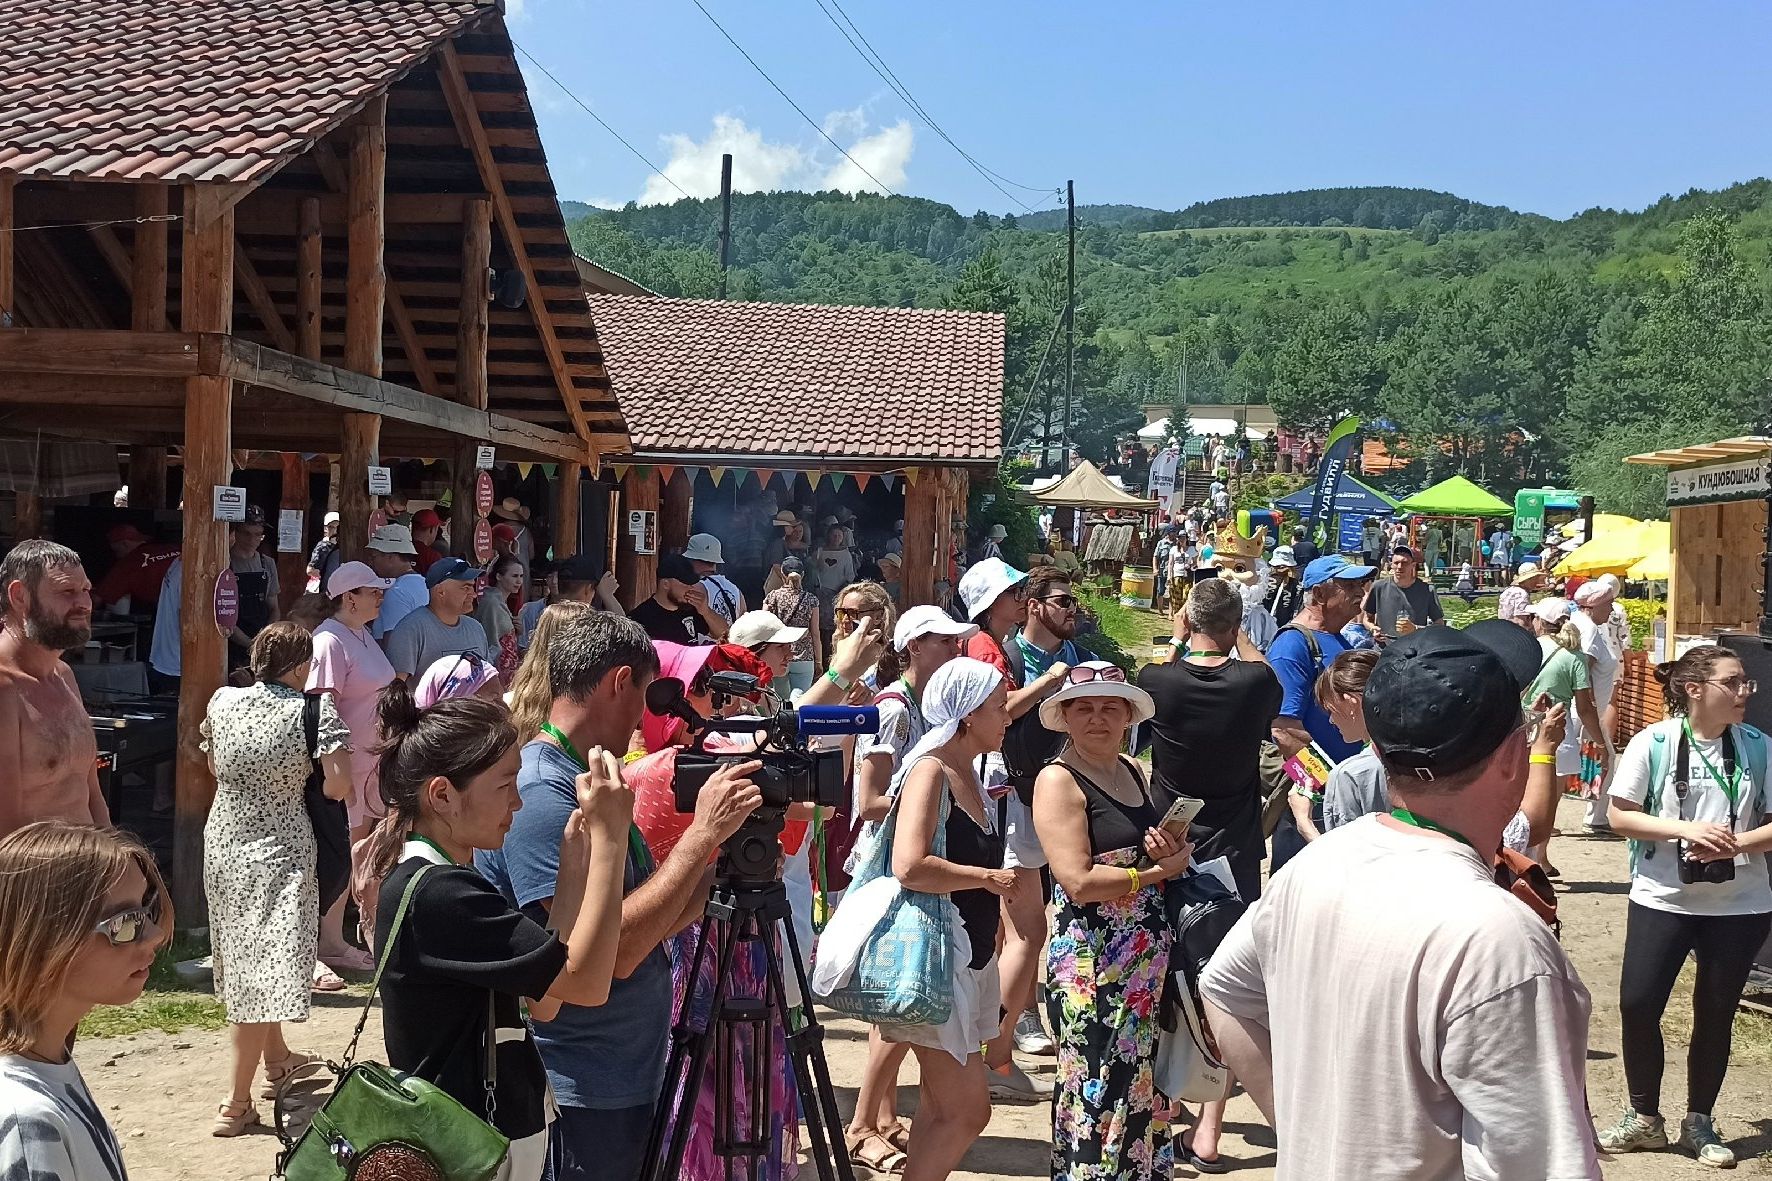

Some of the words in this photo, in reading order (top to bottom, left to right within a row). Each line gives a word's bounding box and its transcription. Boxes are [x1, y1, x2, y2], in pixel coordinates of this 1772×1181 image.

[1318, 459, 1341, 520] ГУДВИЛЛ
[1698, 467, 1760, 491] КУНДЮБОШНАЯ
[1517, 516, 1541, 530] СЫРЫ
